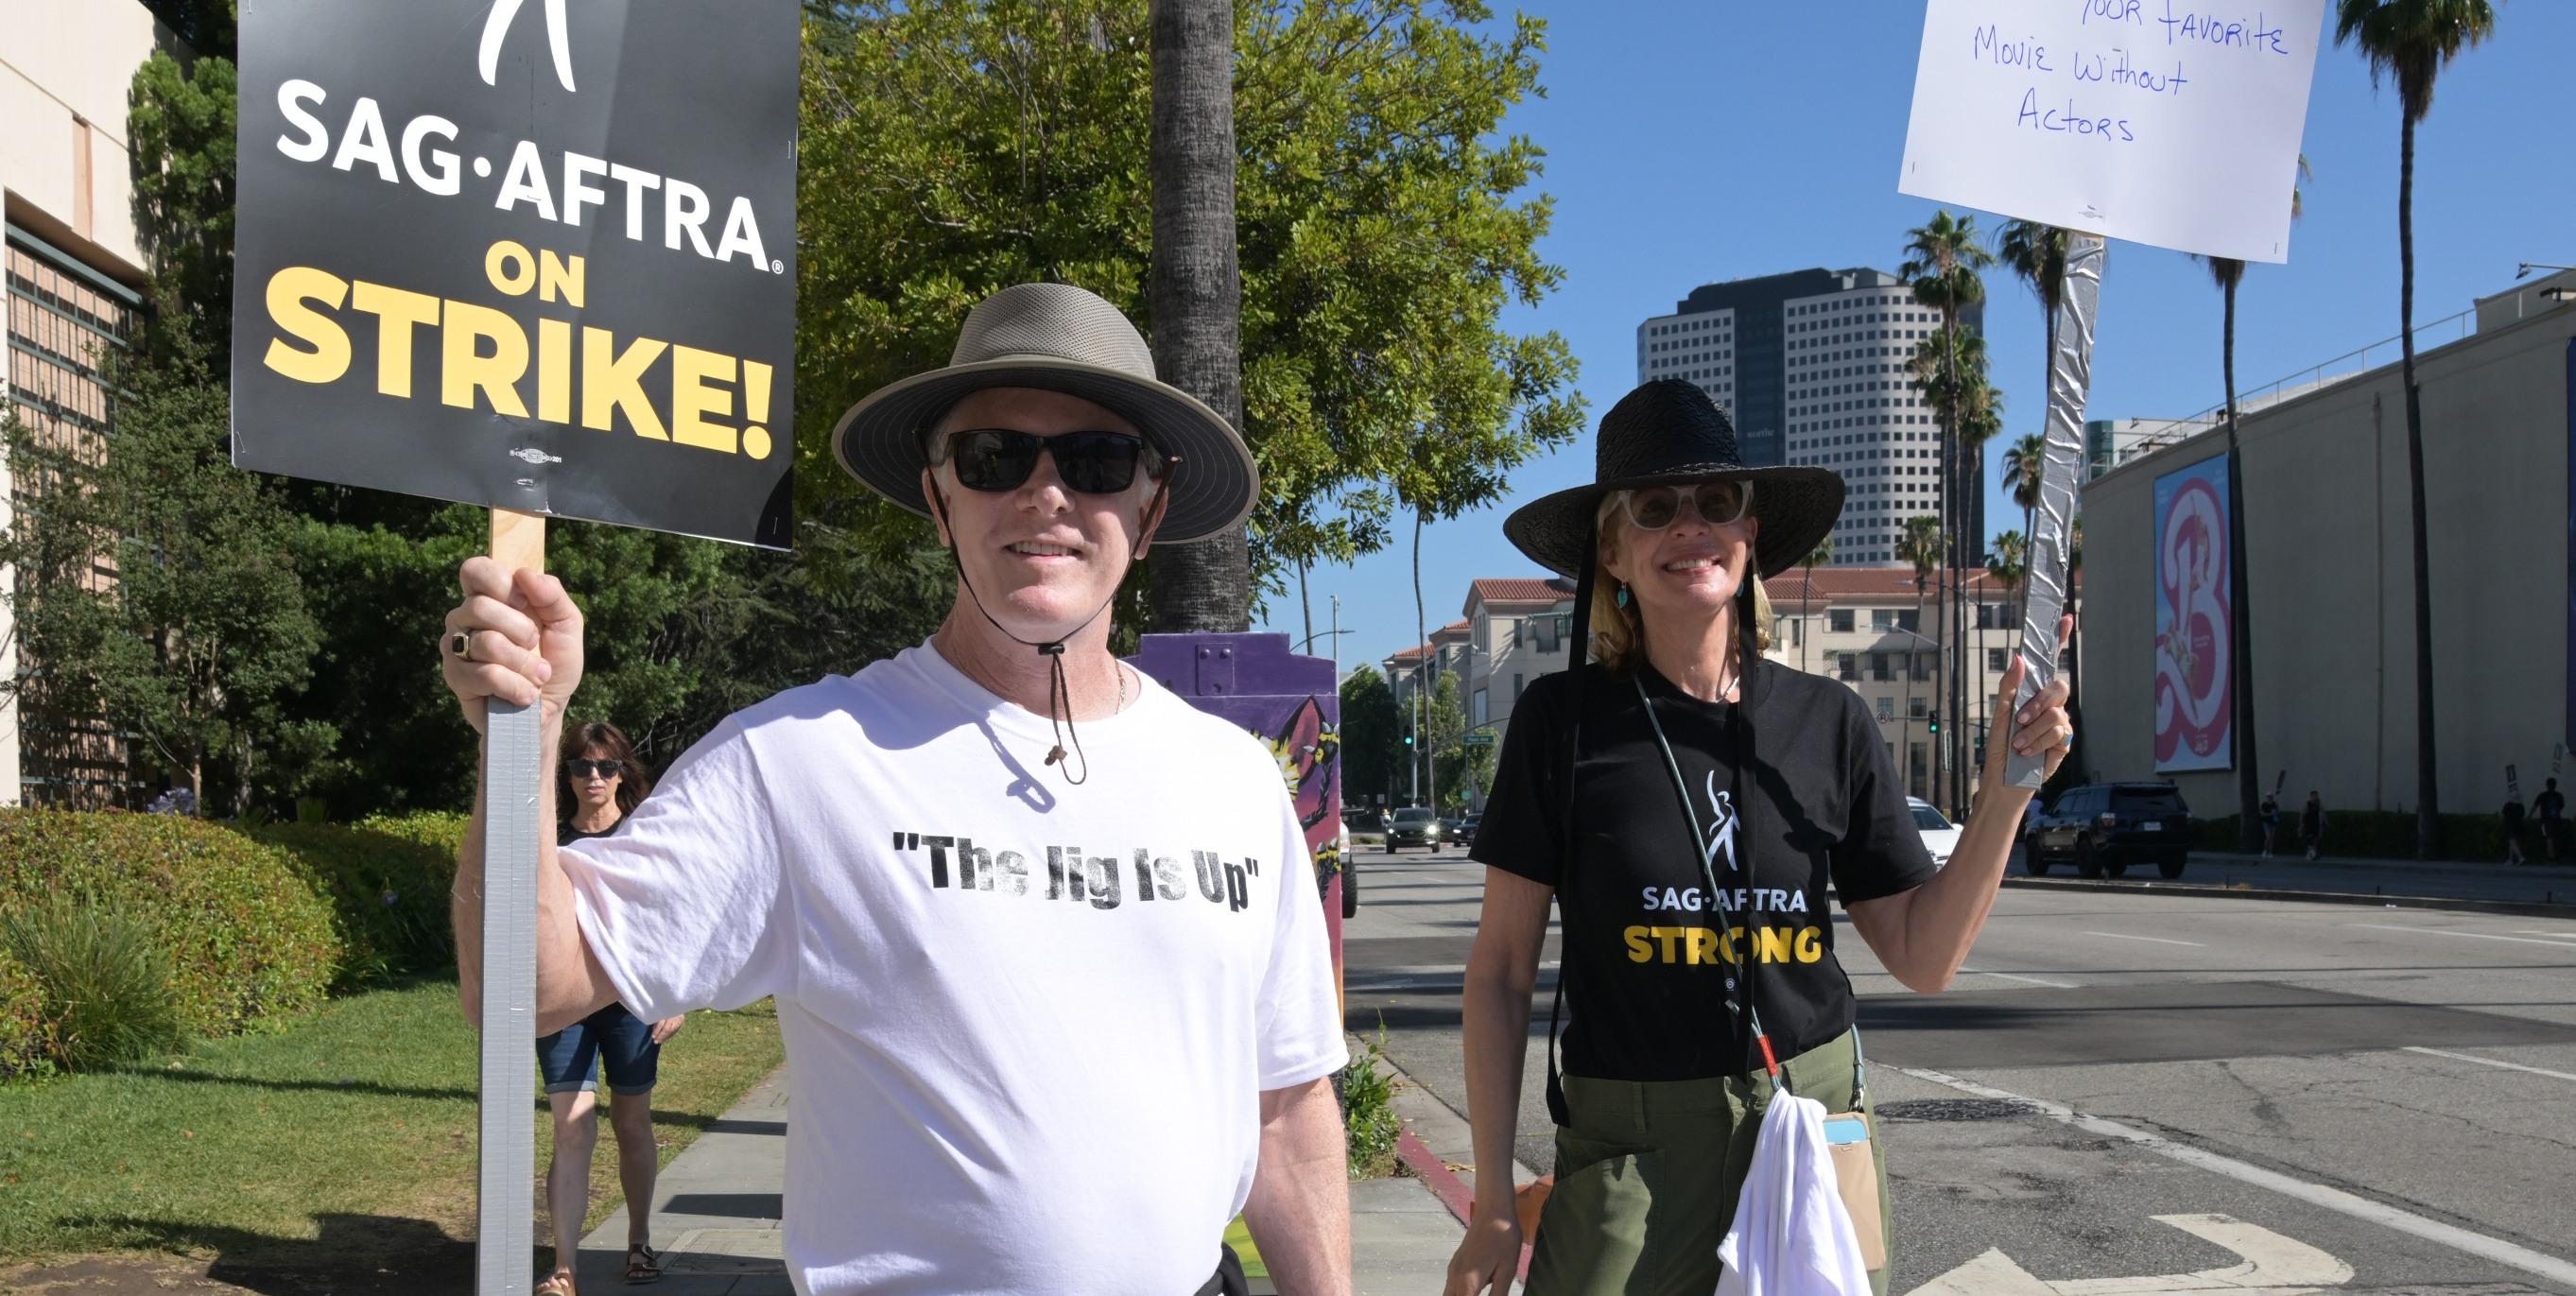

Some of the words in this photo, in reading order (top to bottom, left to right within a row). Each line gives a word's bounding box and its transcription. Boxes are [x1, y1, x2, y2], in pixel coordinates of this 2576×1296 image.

[485, 240, 585, 308] ON
[264, 266, 773, 460] STRIKE!
[892, 831, 1029, 897] "The
[1045, 845, 1121, 910] Jig
[1133, 848, 1186, 902] Is
[1191, 850, 1259, 912] Up"
[1623, 925, 1822, 965] STRONG
